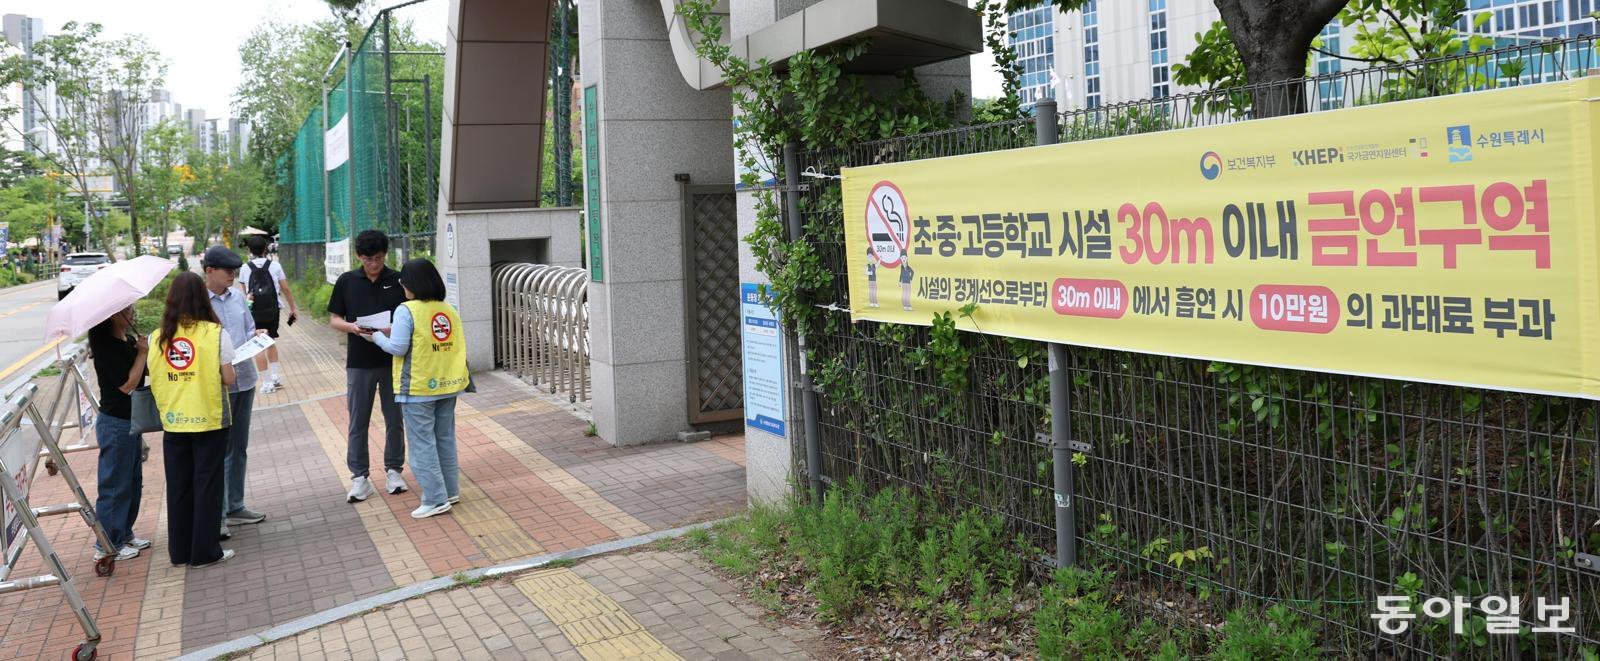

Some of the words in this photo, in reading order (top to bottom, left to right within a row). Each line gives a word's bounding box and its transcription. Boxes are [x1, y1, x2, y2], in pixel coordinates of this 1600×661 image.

[1475, 128, 1545, 149] 수원특례시
[1227, 155, 1276, 170] 보건복지부
[1346, 147, 1407, 161] 국가금연지원센터
[1058, 209, 1112, 260] 시설
[1117, 202, 1214, 265] 30m
[1222, 199, 1299, 261] 이내
[1307, 179, 1551, 269] 금연구역
[917, 276, 952, 301] 시설의
[954, 278, 1048, 308] 경계선으로부터
[1057, 285, 1089, 308] 30m
[1093, 286, 1122, 312] 이내
[1132, 285, 1170, 317] 에서
[1175, 286, 1217, 320] 흡연
[1222, 288, 1244, 322] 시
[1259, 293, 1328, 324] 10만원
[1346, 292, 1373, 330] 의
[1381, 294, 1475, 335] 과태료
[1483, 297, 1556, 341] 부과
[168, 372, 178, 381] No
